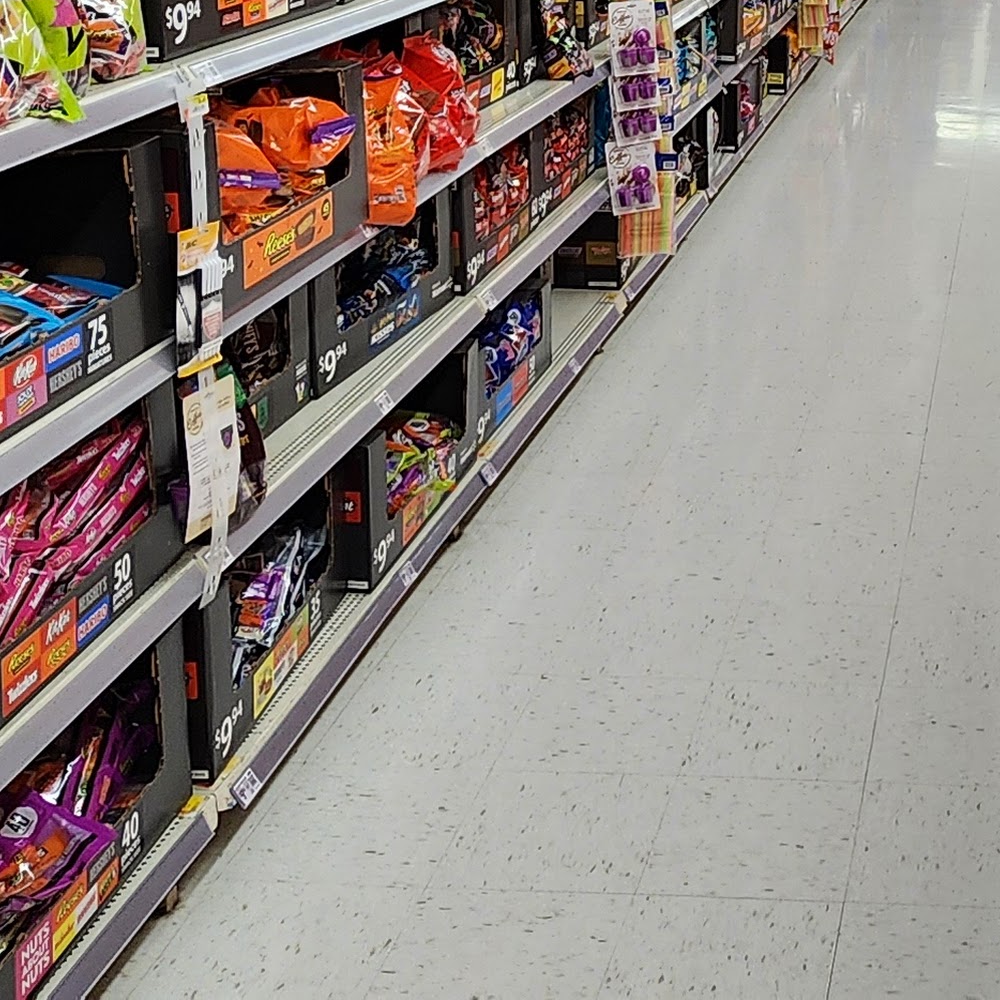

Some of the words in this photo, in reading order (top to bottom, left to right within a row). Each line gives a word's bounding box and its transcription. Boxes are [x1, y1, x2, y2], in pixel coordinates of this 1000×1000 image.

[165, 0, 201, 45] $994
[466, 249, 485, 286] $994
[48, 332, 80, 364] HARIBO
[87, 313, 108, 350] 75
[318, 341, 348, 383] $994
[372, 529, 395, 572] $994
[113, 553, 131, 590] 50
[215, 699, 243, 757] $994
[121, 811, 139, 847] 40
[21, 921, 49, 966] NUTS
[21, 938, 50, 979] ABOUT
[21, 951, 50, 996] NUTS
